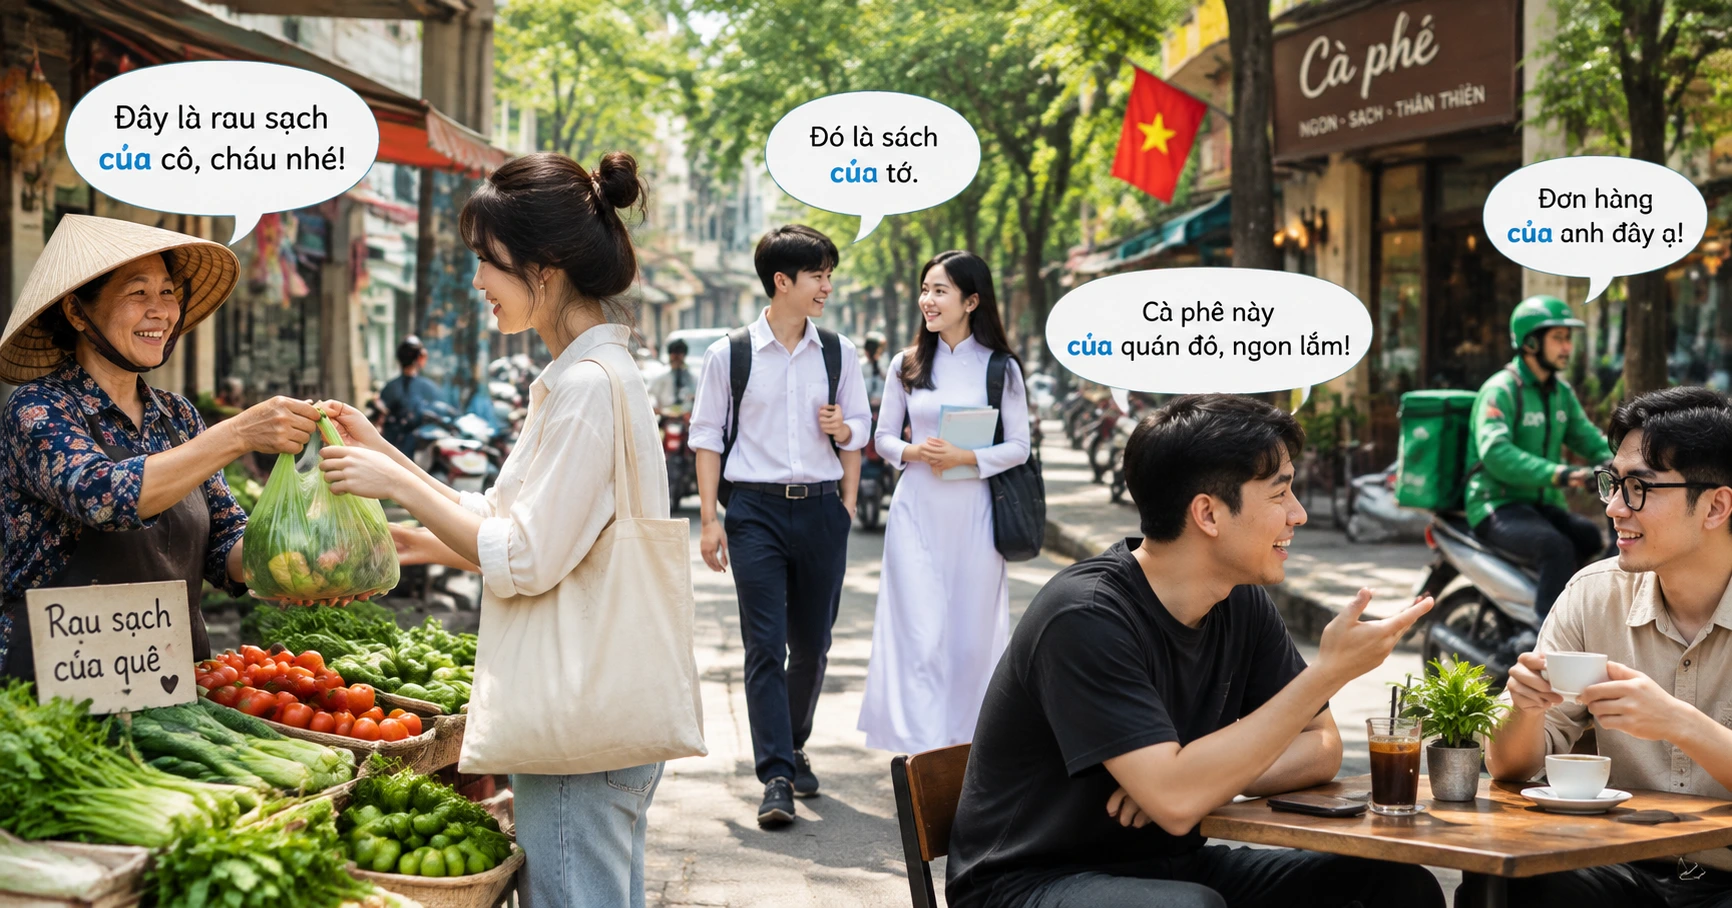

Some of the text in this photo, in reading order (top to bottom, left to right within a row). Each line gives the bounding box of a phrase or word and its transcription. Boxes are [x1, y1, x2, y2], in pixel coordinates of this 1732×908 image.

[1300, 35, 1357, 99] Cà
[1298, 114, 1338, 137] NGON
[112, 598, 172, 637] sạch
[114, 645, 161, 685] quê
